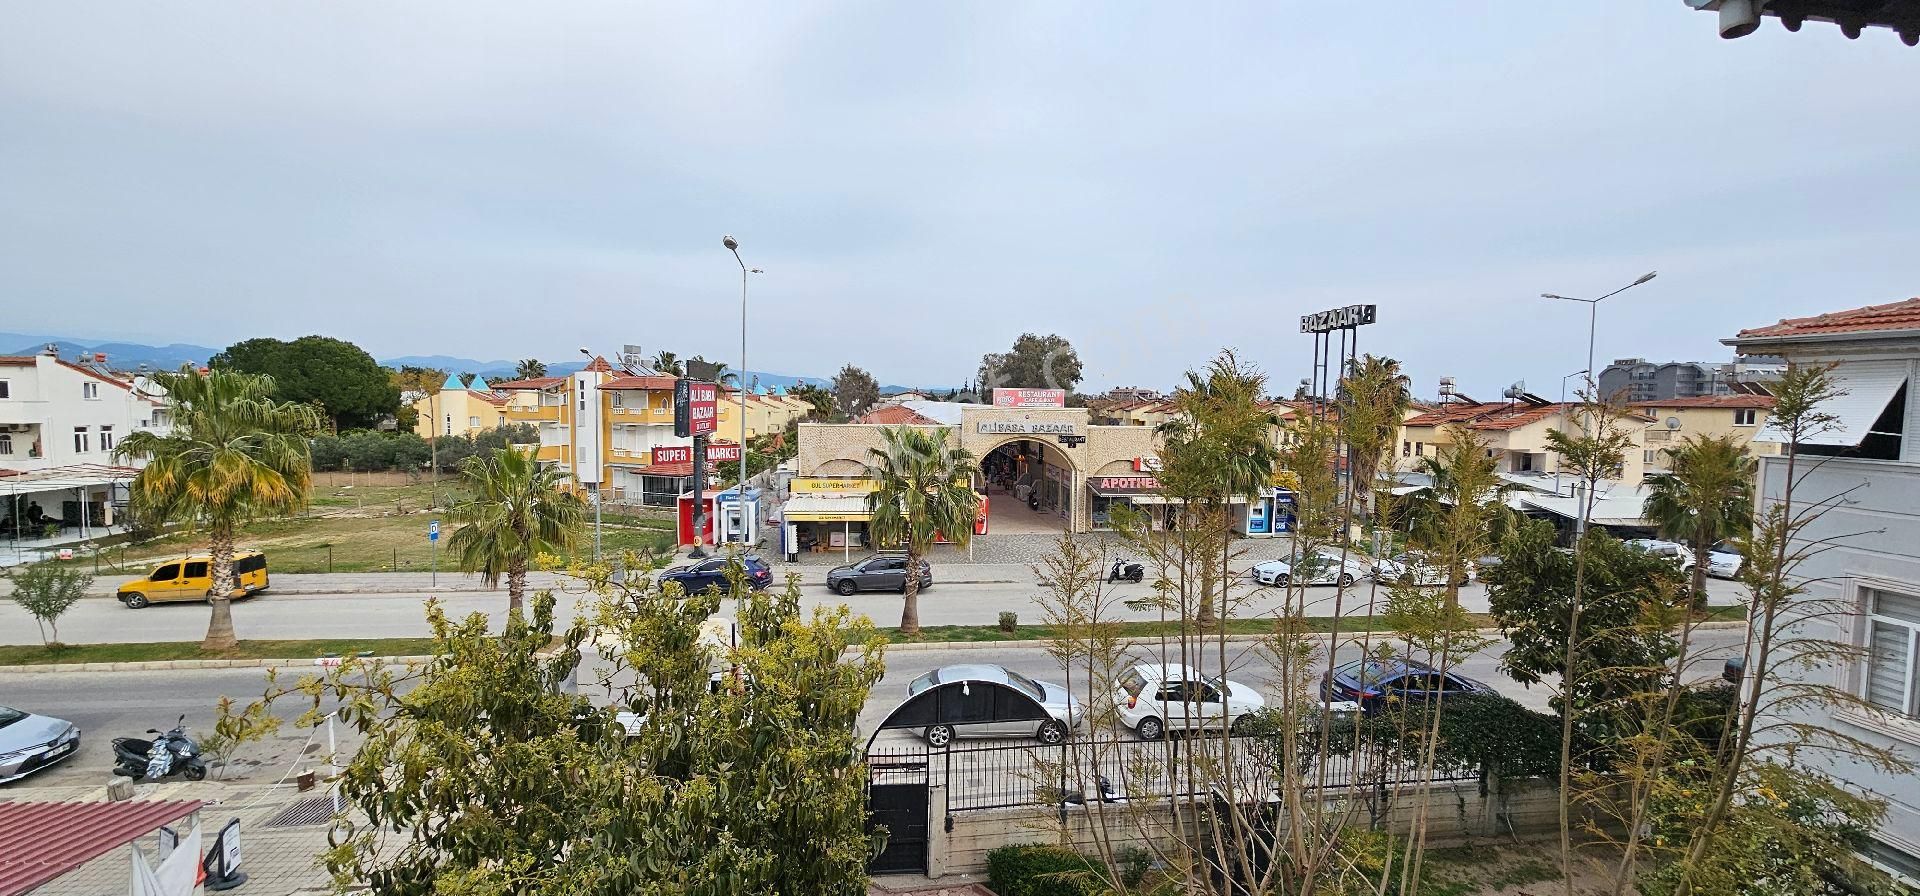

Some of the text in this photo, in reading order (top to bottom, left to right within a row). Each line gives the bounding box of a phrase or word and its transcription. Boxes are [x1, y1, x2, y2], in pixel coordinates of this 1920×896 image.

[1300, 305, 1359, 333] BAZAAR
[701, 389, 715, 402] BABA
[1018, 390, 1061, 398] RESTAURANT
[692, 406, 714, 420] BAZAAR
[1031, 423, 1074, 433] BAZAAR
[657, 447, 741, 462] SUPER MARKET
[1100, 477, 1167, 489] APOTHE
